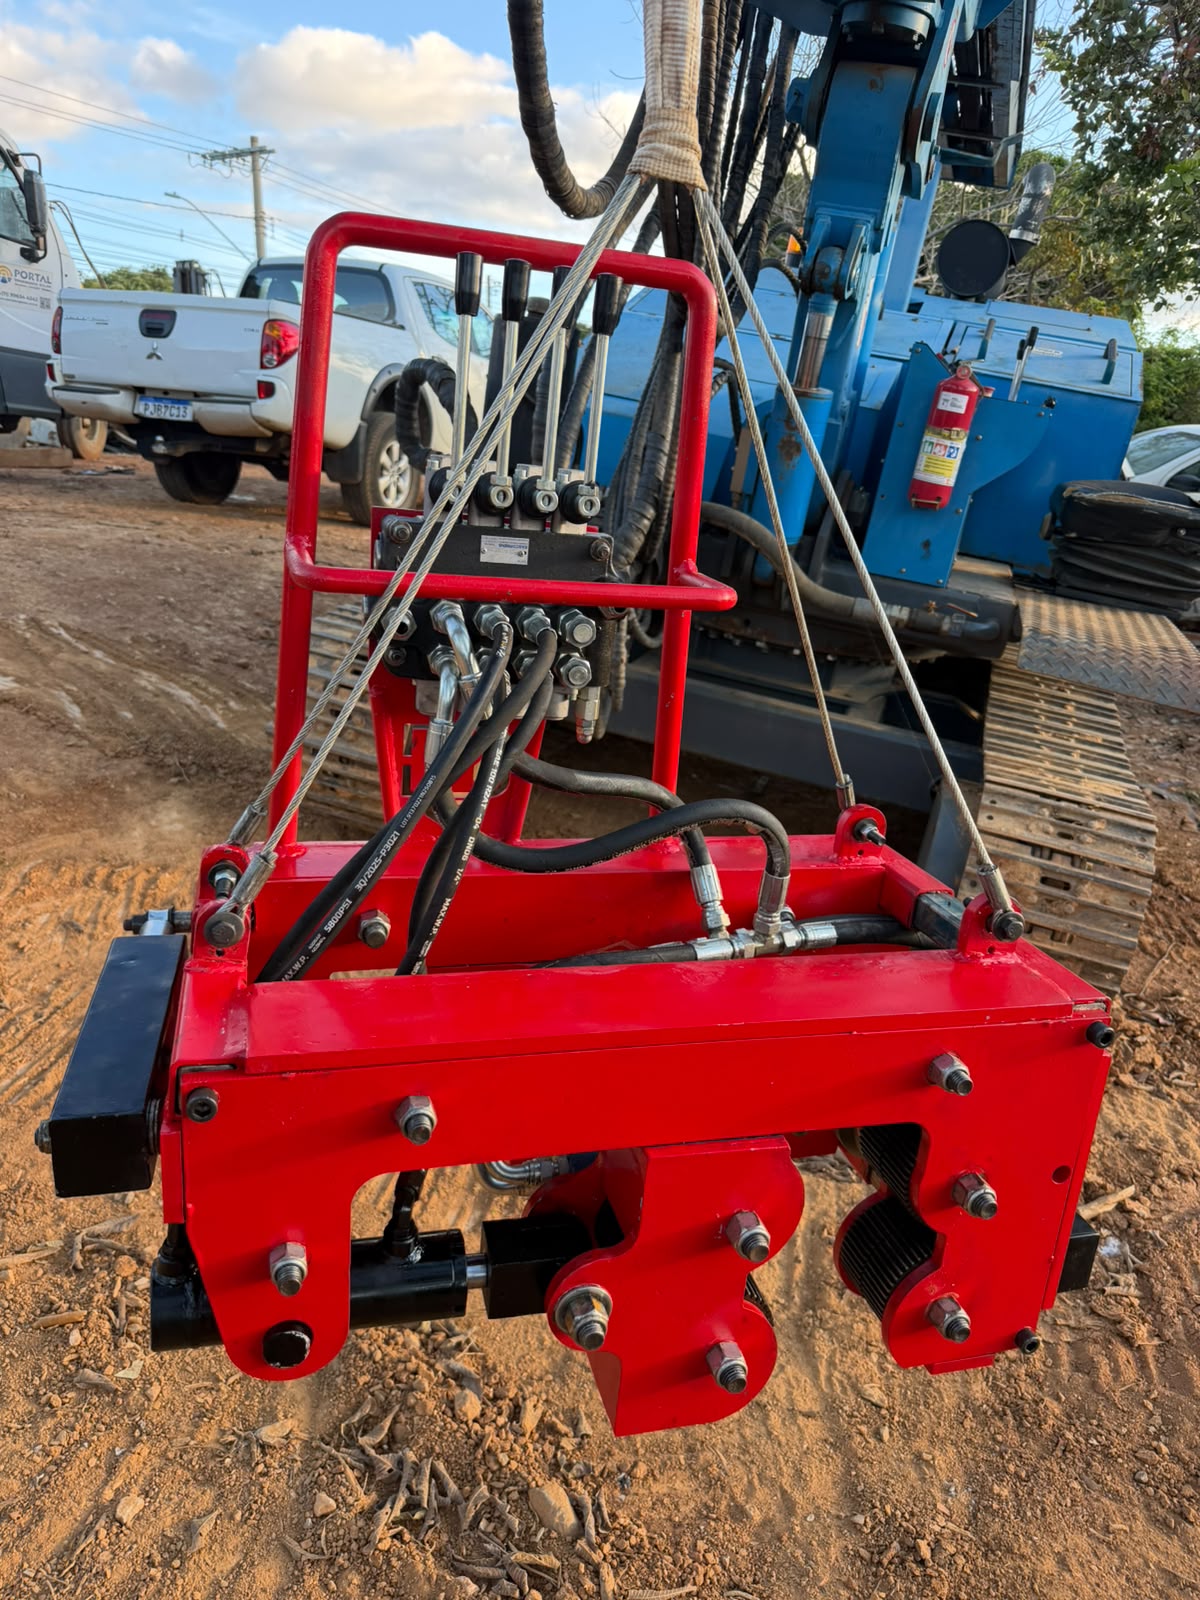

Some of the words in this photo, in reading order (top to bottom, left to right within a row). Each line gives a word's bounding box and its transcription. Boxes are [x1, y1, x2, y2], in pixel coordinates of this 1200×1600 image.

[14, 269, 52, 284] PORTAL
[487, 765, 499, 784] 100
[323, 898, 352, 934] 5800PSI
[354, 830, 400, 892] 3Q/2025-P3021
